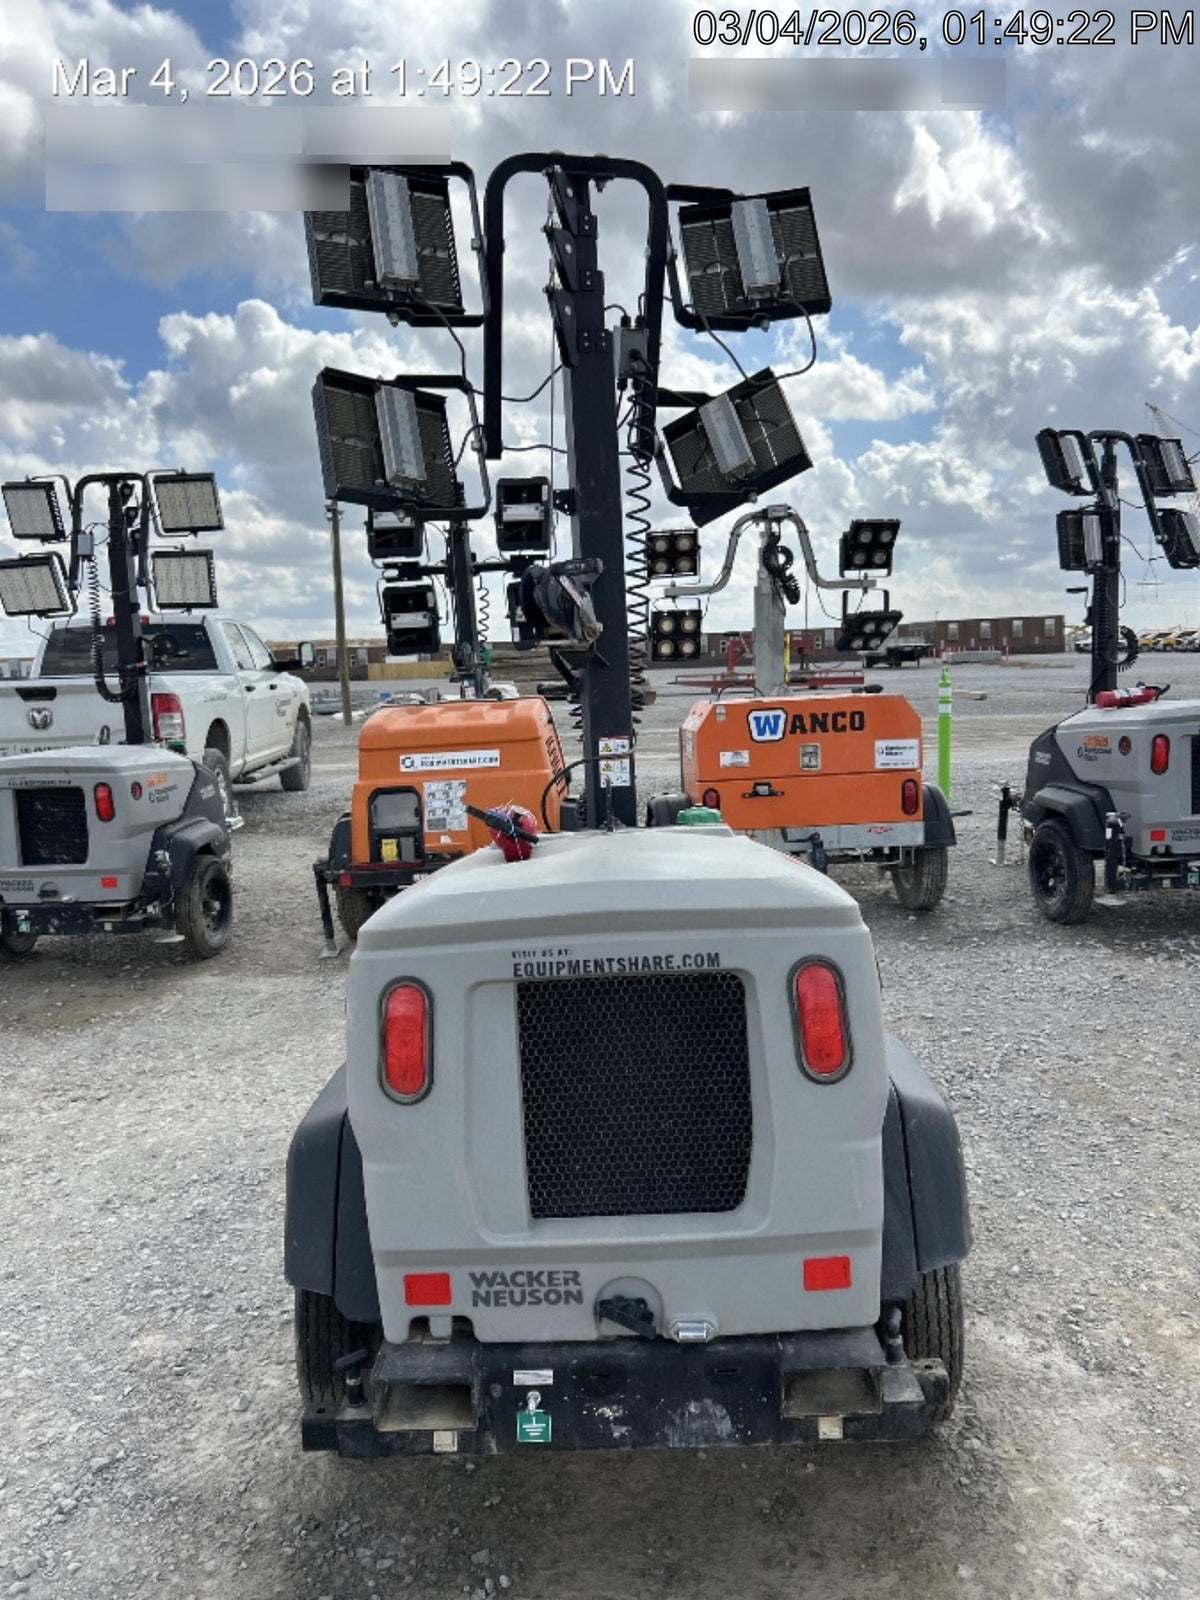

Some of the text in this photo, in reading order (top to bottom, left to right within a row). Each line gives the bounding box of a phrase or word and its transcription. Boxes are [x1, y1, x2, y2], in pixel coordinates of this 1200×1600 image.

[752, 710, 865, 737] WANCO
[513, 952, 720, 979] EQUIPMENTSHARE.COM
[468, 1270, 582, 1289] WACKER
[471, 1288, 584, 1308] NEUSON
